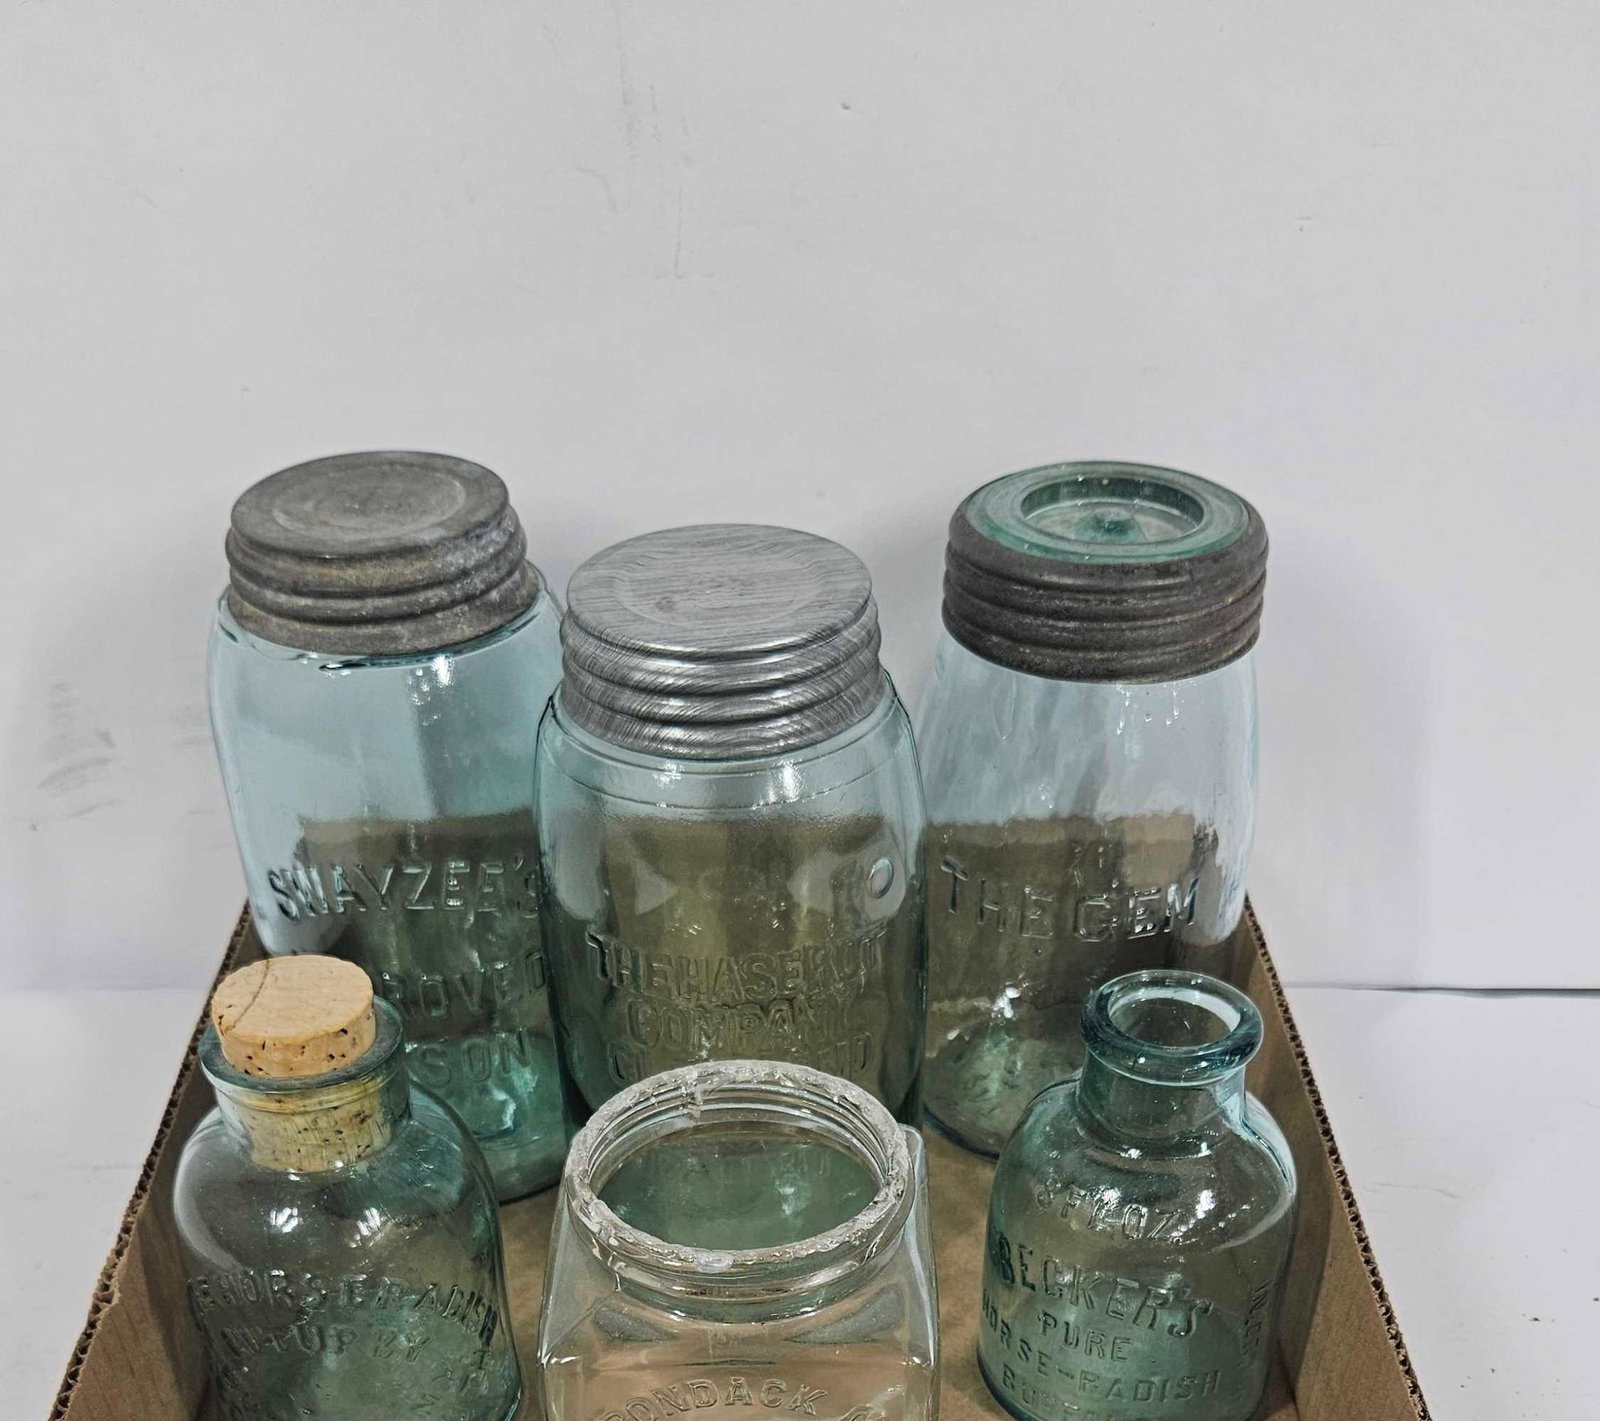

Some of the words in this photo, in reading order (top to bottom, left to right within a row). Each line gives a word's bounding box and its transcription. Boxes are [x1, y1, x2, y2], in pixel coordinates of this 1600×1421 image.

[940, 855, 1054, 940] THE
[1072, 877, 1200, 942] GEM
[380, 950, 546, 1018] ROVED
[402, 1026, 533, 1088] SON
[292, 1322, 357, 1354] UP
[373, 1327, 432, 1362] BY
[982, 1288, 1221, 1402] HORSE-RADISH
[1037, 1310, 1131, 1363] PURE
